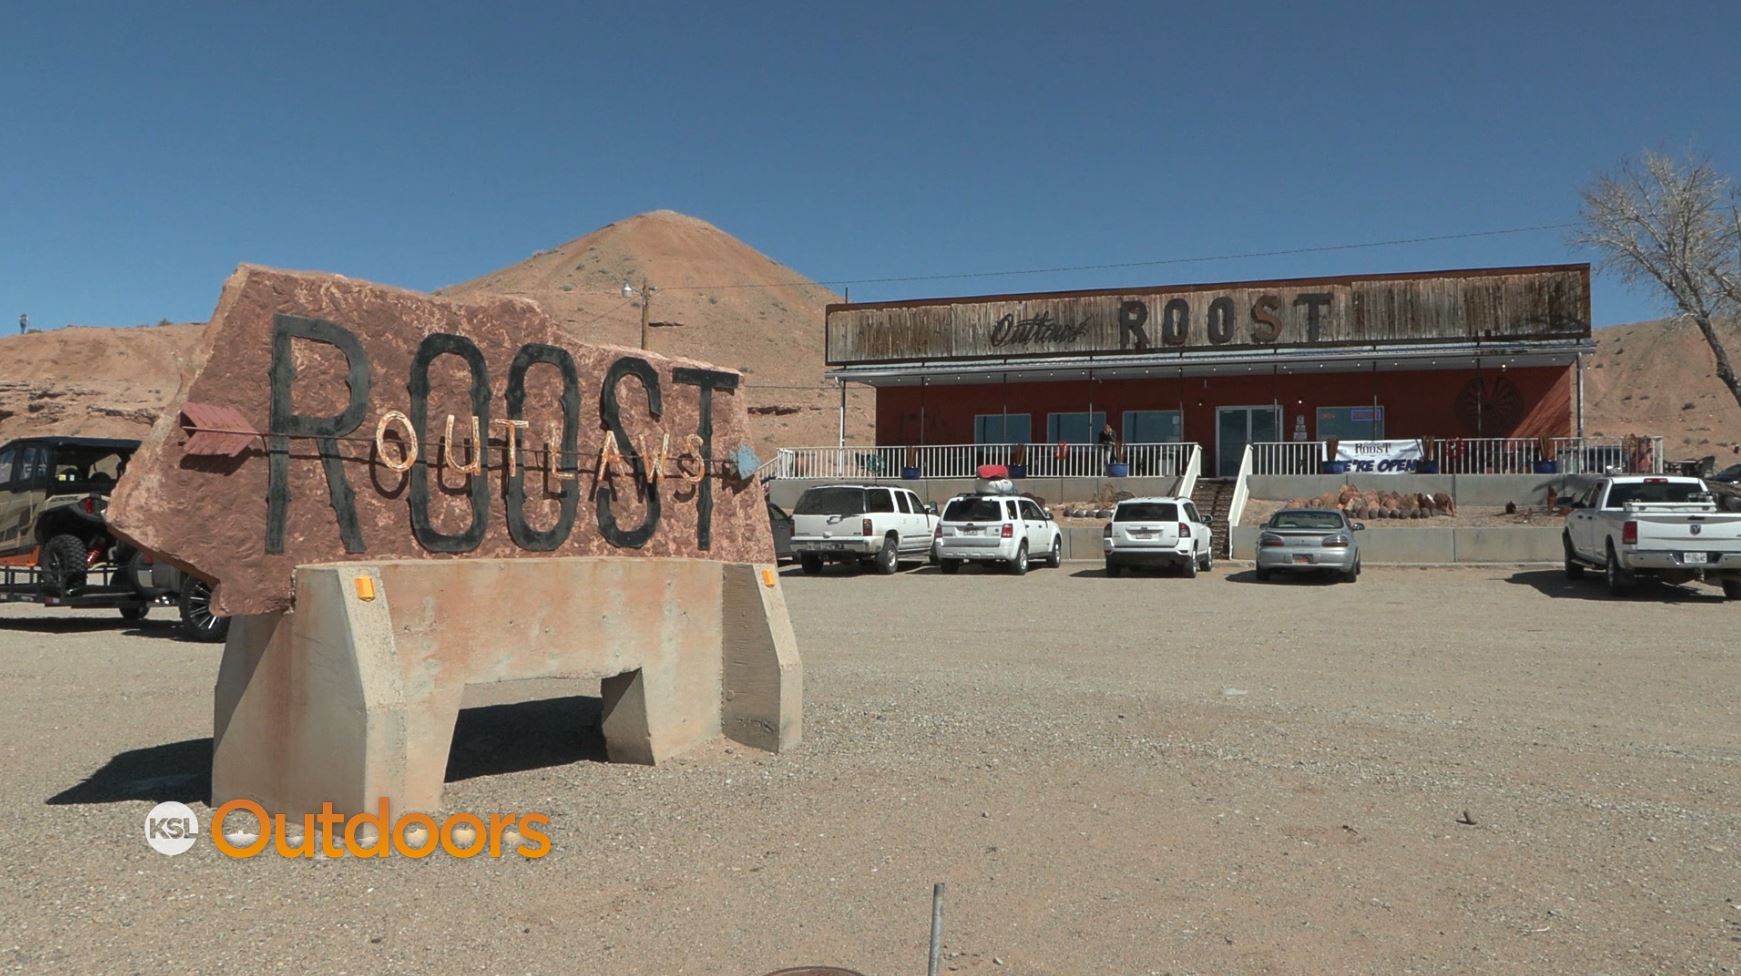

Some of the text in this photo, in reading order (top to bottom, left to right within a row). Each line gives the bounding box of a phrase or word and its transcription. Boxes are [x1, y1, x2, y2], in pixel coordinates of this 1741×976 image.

[1119, 292, 1335, 350] ROOST
[264, 313, 740, 555] ROOST
[375, 409, 706, 485] OUTLAWS
[1342, 459, 1375, 473] E'RE
